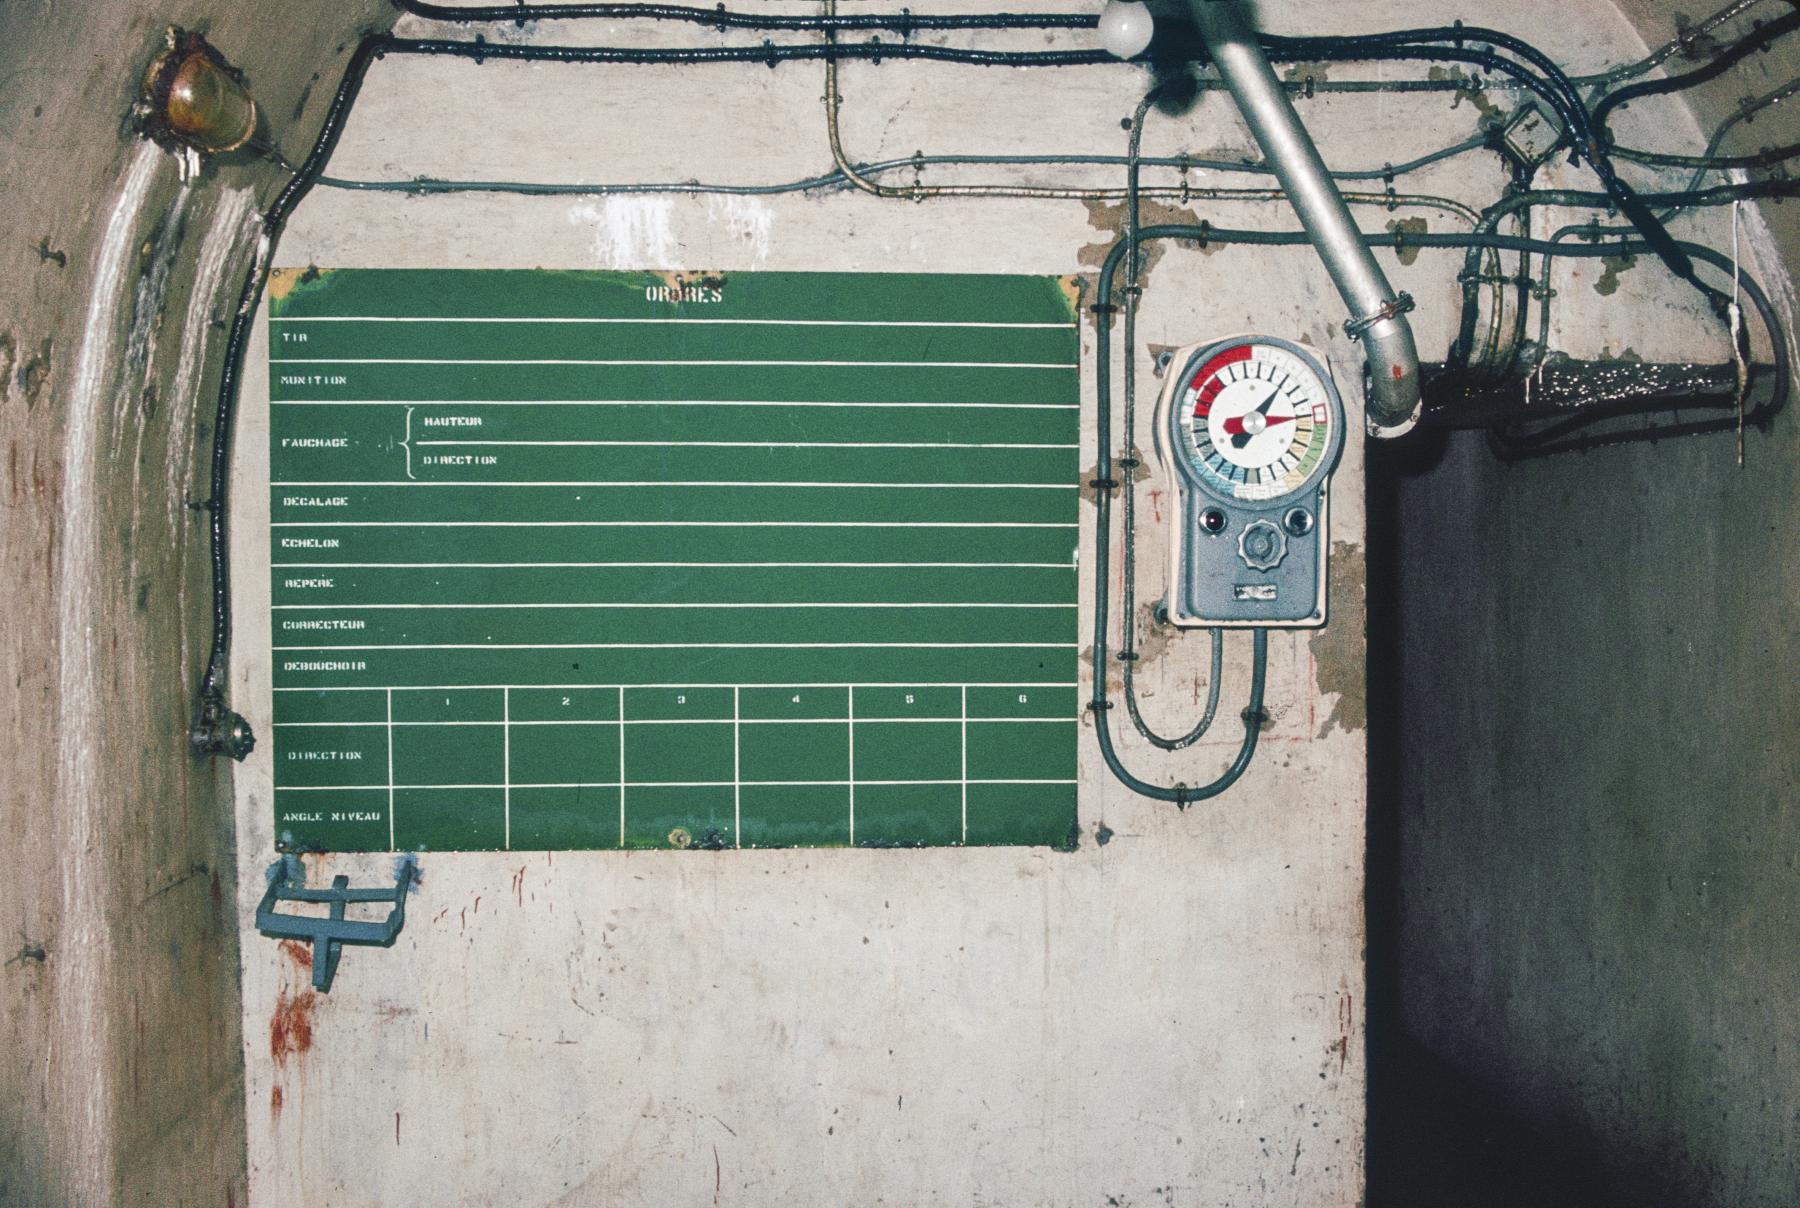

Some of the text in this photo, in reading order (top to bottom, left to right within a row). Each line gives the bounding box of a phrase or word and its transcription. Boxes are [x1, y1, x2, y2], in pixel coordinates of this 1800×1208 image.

[645, 285, 723, 303] ORDRES
[282, 332, 308, 342] TIR
[280, 375, 347, 385] MUNITION
[423, 416, 483, 427] HAUTEUR
[281, 438, 349, 448] FAUCHAGE
[422, 455, 498, 465] DIRECTION
[283, 496, 349, 507] DECALAGE
[281, 538, 340, 549] ECHELON
[284, 578, 335, 589] REPERE
[282, 619, 366, 631] CORRECTEUR
[283, 660, 367, 671] DEBOUCHOIR
[561, 696, 571, 706] 2
[676, 695, 686, 705] 3
[791, 694, 801, 704] 4
[904, 694, 914, 704] 5
[1018, 694, 1028, 704] 6
[287, 751, 363, 761] DIRECTION
[282, 811, 381, 822] ANGLE NIVEAU
